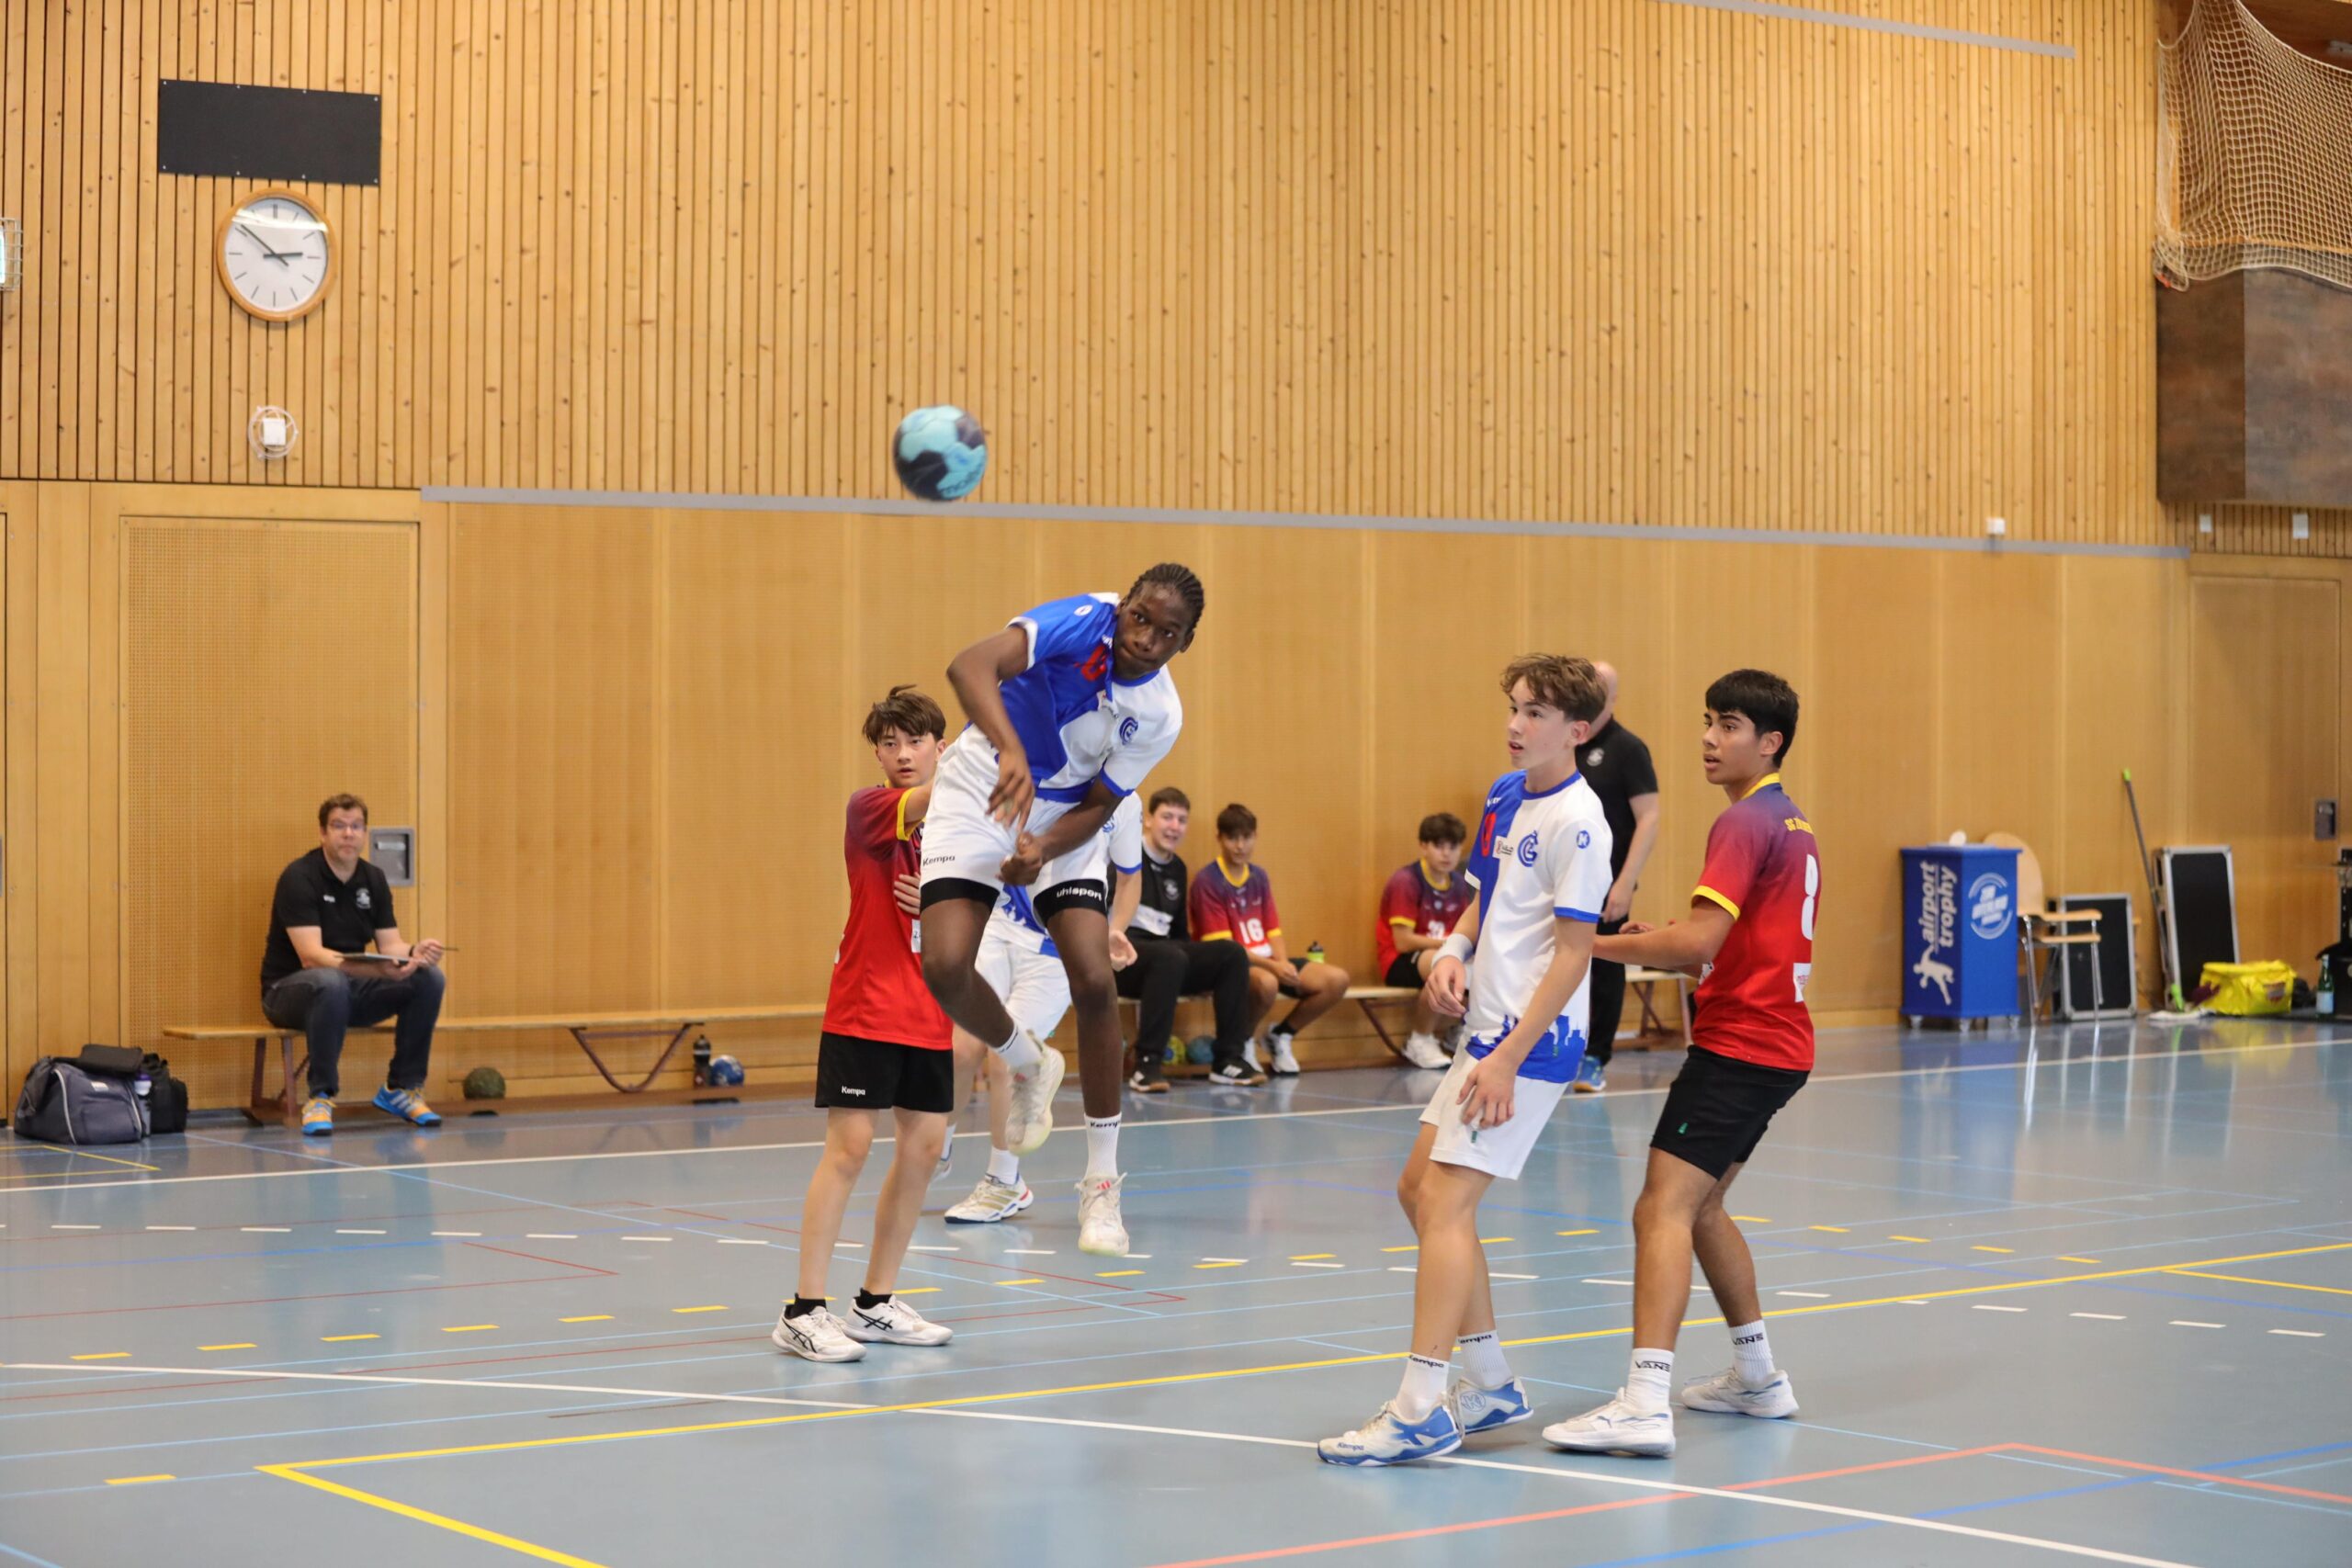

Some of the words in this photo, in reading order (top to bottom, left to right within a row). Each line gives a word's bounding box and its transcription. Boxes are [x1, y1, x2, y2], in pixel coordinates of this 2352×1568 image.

[922, 855, 956, 867] Kempa
[1918, 860, 1939, 943] airport
[1938, 865, 1957, 948] trophy
[1238, 918, 1265, 944] 16
[842, 1085, 865, 1097] Kempa
[1732, 1332, 1764, 1346] VANS
[1635, 1360, 1671, 1372] VANS
